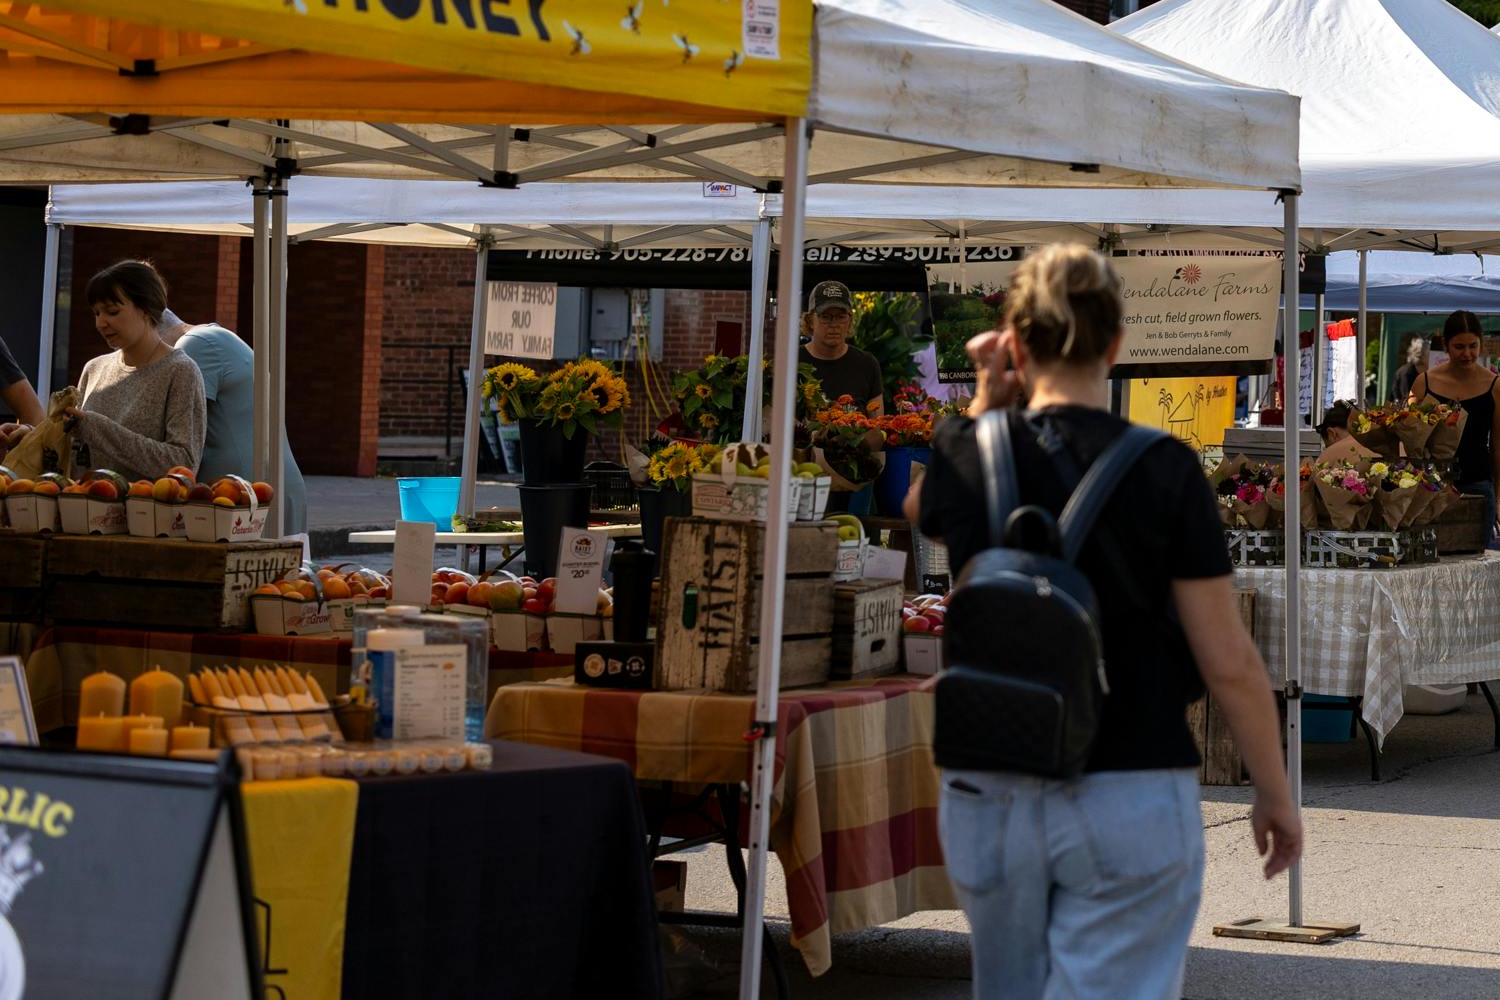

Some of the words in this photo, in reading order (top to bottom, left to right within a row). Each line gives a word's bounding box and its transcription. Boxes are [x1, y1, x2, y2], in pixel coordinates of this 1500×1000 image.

[802, 246, 840, 261] ell:
[1213, 272, 1273, 301] Farms
[1121, 312, 1142, 324] resh
[1145, 313, 1162, 325] cut,
[1165, 312, 1187, 323] field
[1188, 313, 1220, 325] grown
[1223, 310, 1262, 322] flowers.
[1145, 332, 1157, 340] Jen
[1158, 332, 1164, 340] &
[1165, 331, 1178, 339] Bob
[1210, 330, 1232, 340] Family
[1129, 343, 1249, 357] www.wendalane.com
